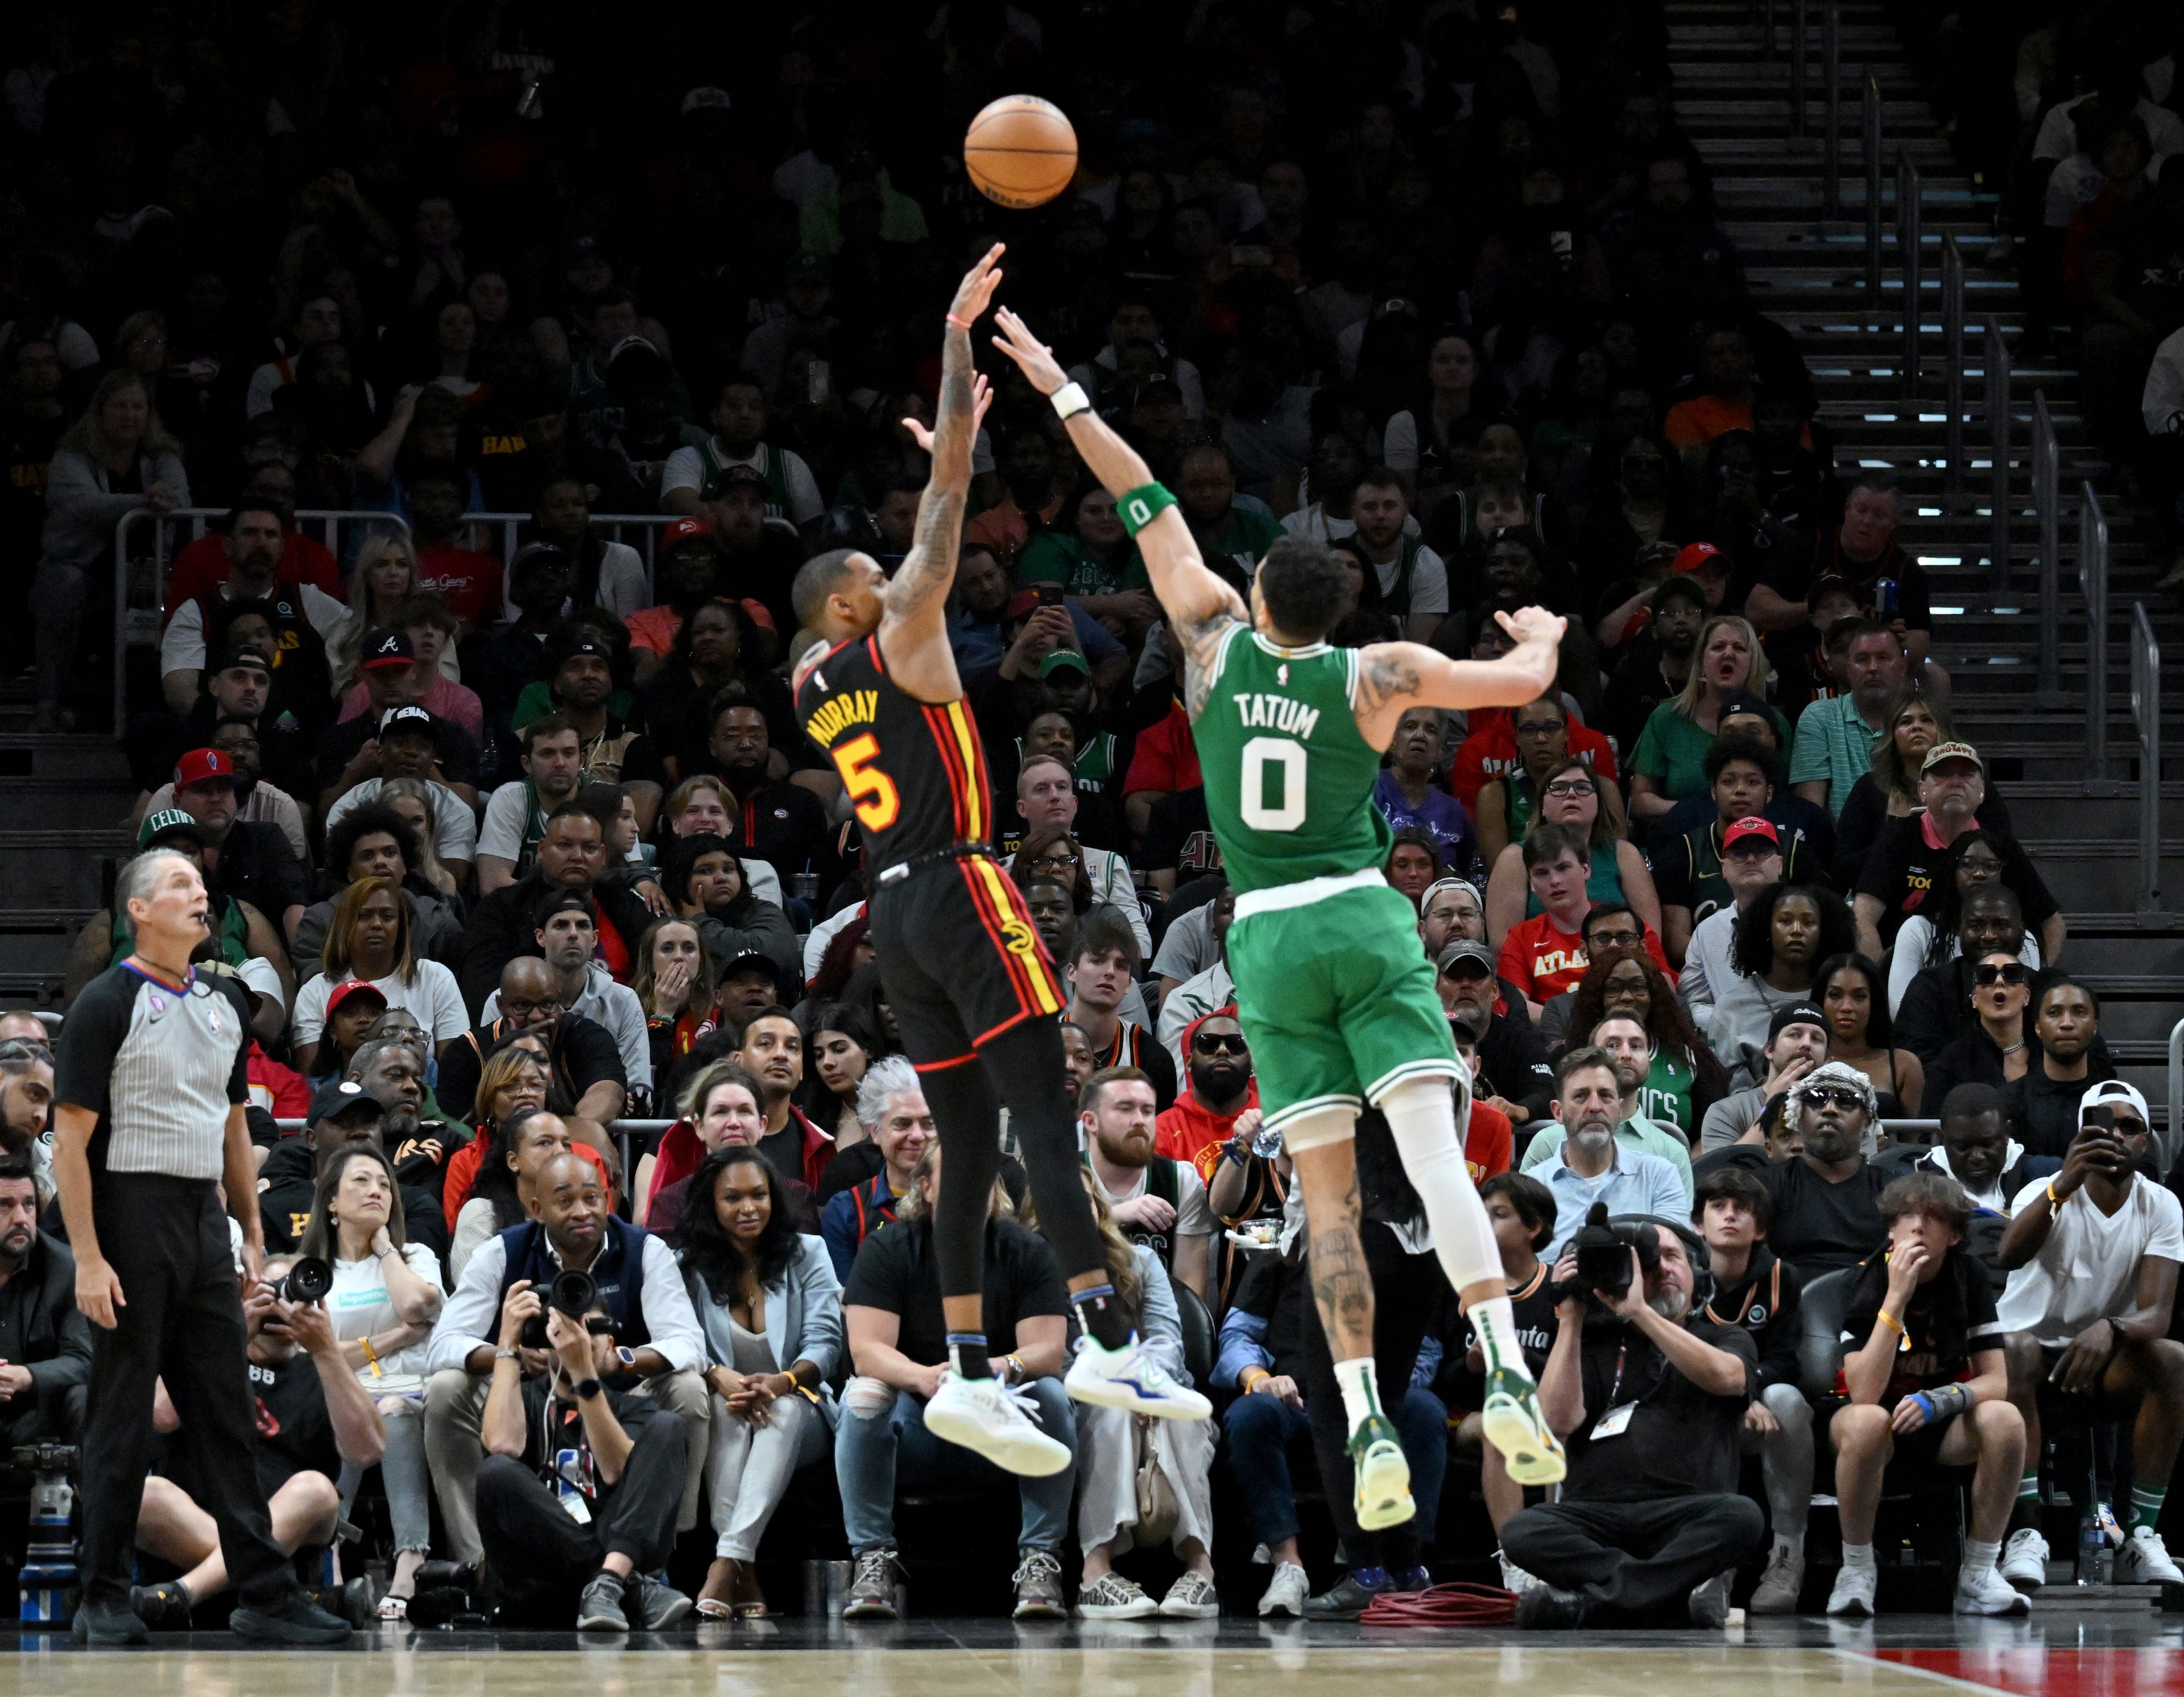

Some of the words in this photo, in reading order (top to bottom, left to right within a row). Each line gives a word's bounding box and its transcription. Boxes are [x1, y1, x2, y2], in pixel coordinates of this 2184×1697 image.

[1128, 499, 1152, 526] 0
[806, 689, 879, 749] MURRAY
[1232, 693, 1320, 740] TATUM
[833, 731, 900, 833] 5
[1240, 736, 1307, 832] 0
